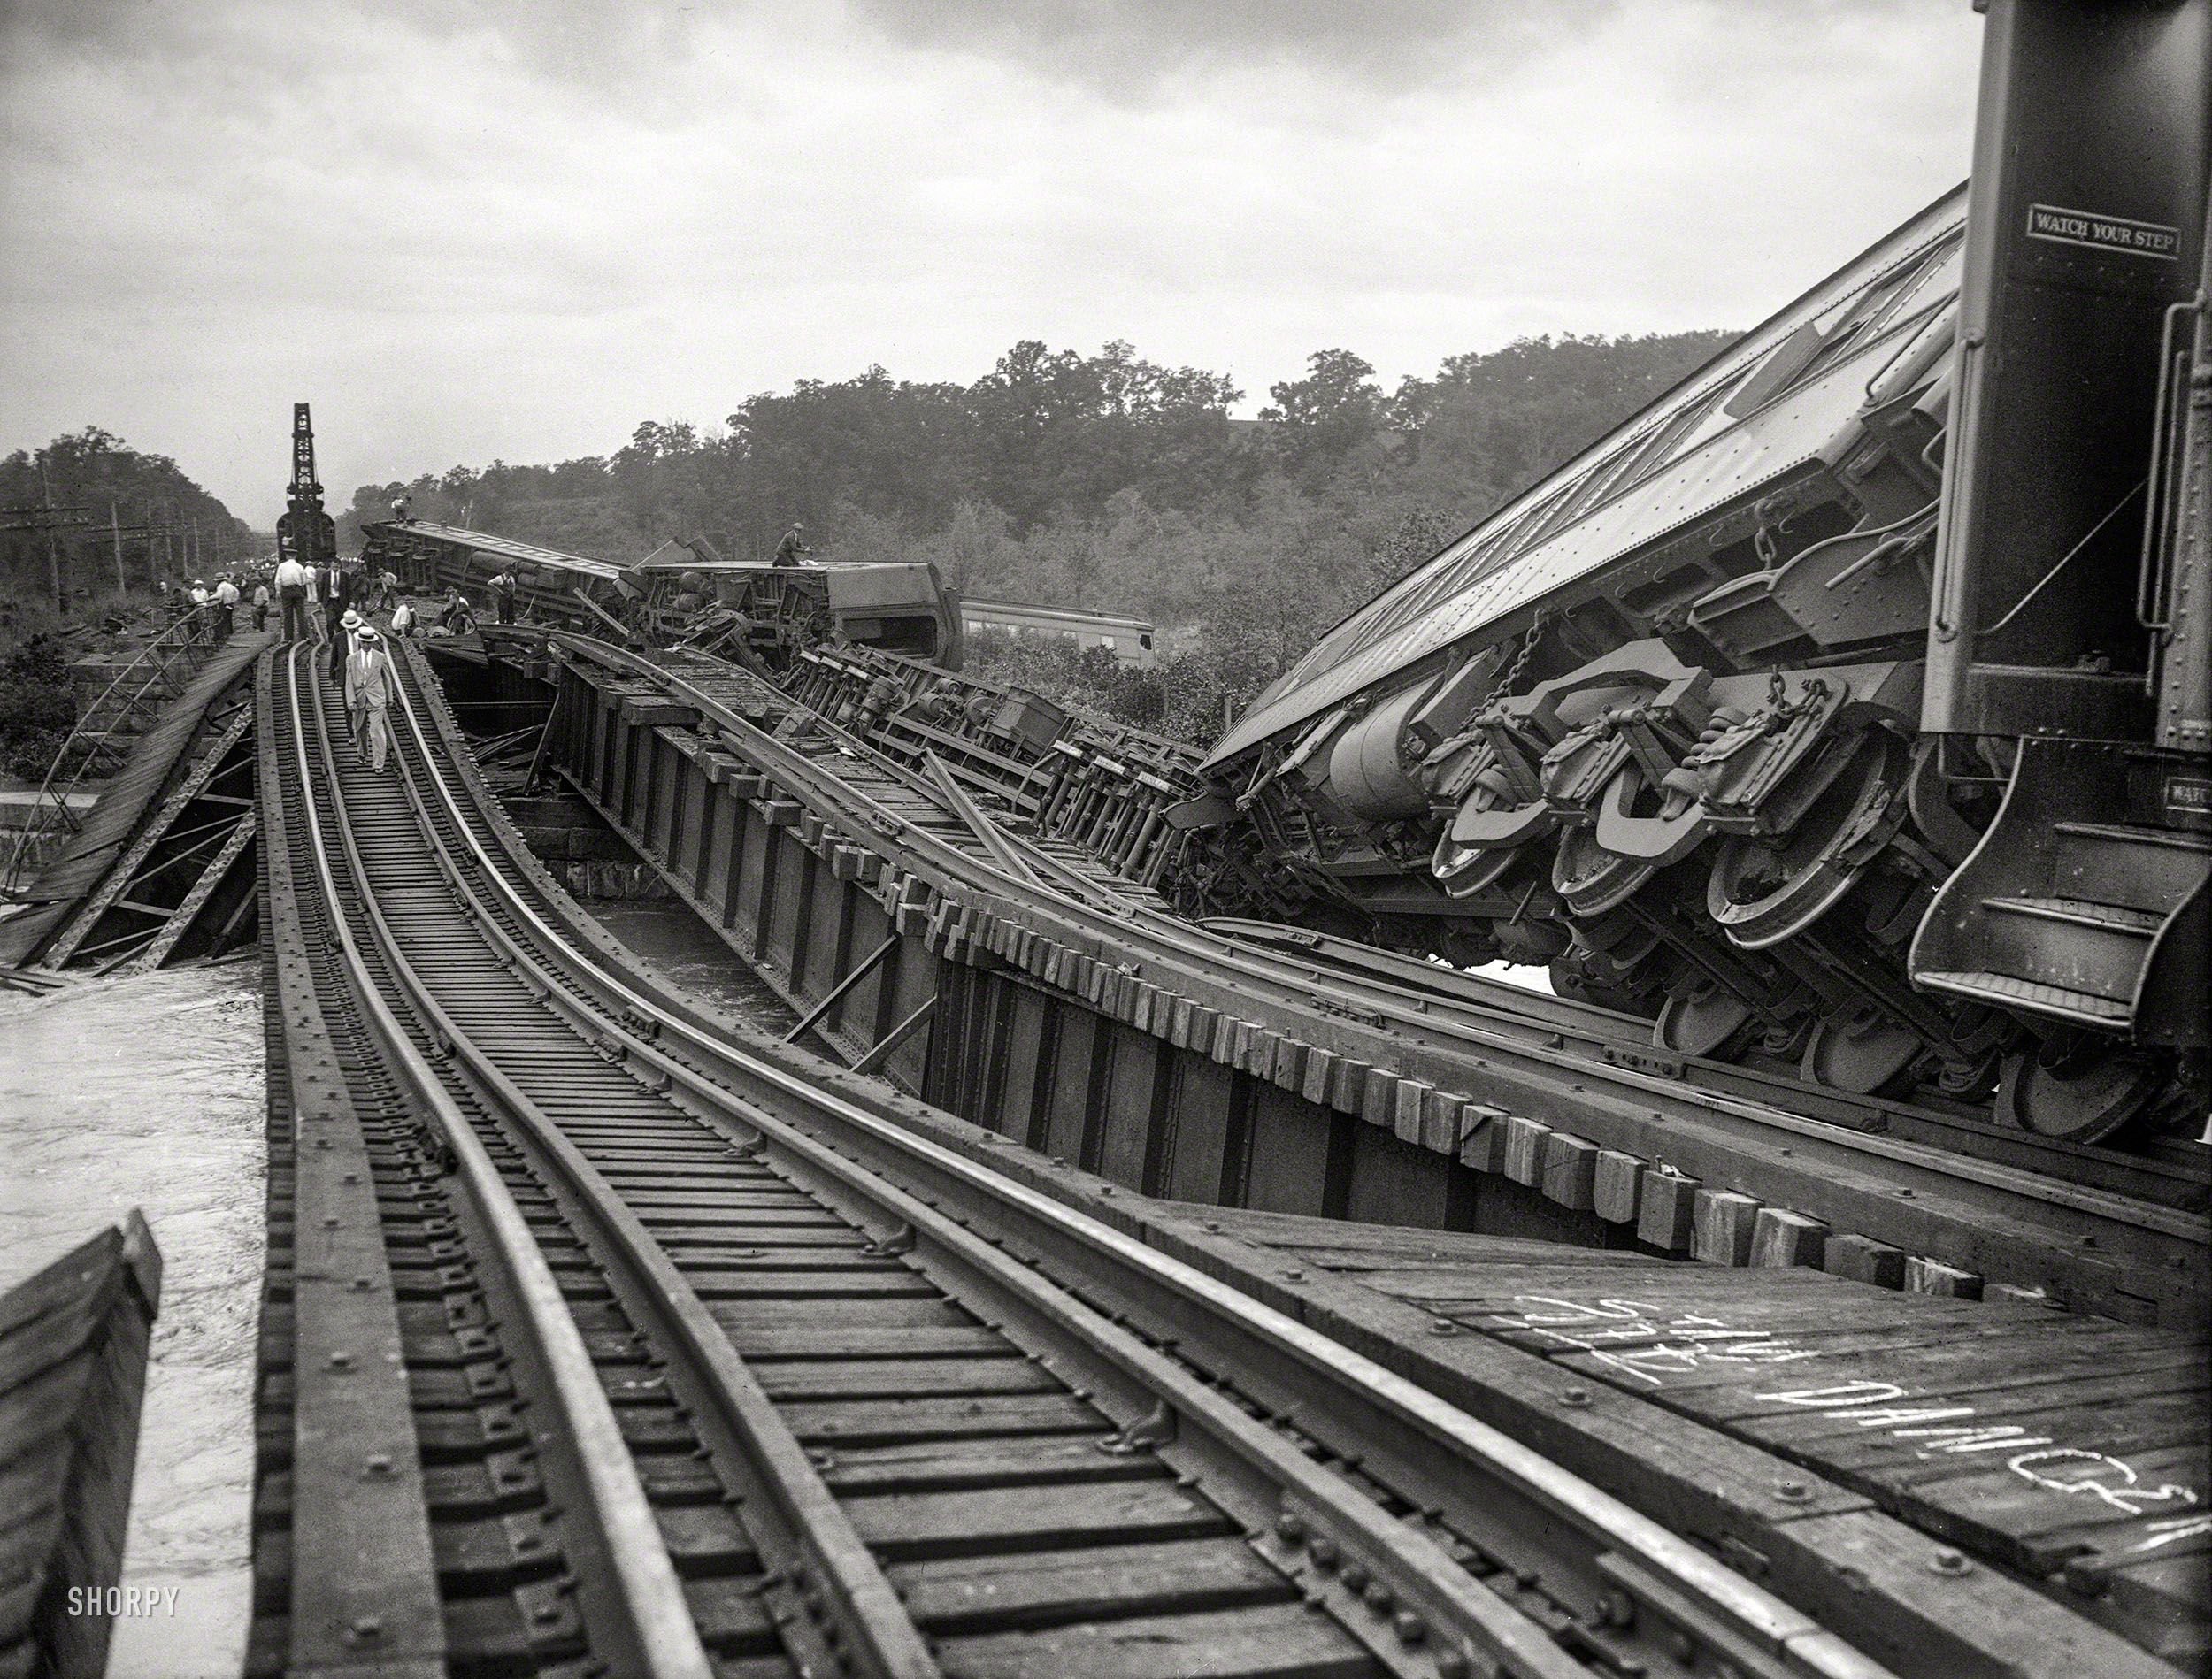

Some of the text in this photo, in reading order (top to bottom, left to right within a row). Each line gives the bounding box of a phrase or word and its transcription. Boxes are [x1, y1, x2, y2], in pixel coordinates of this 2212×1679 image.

[2037, 213, 2173, 249] WATCH YOUR STEP
[2172, 786, 2212, 803] WATC
